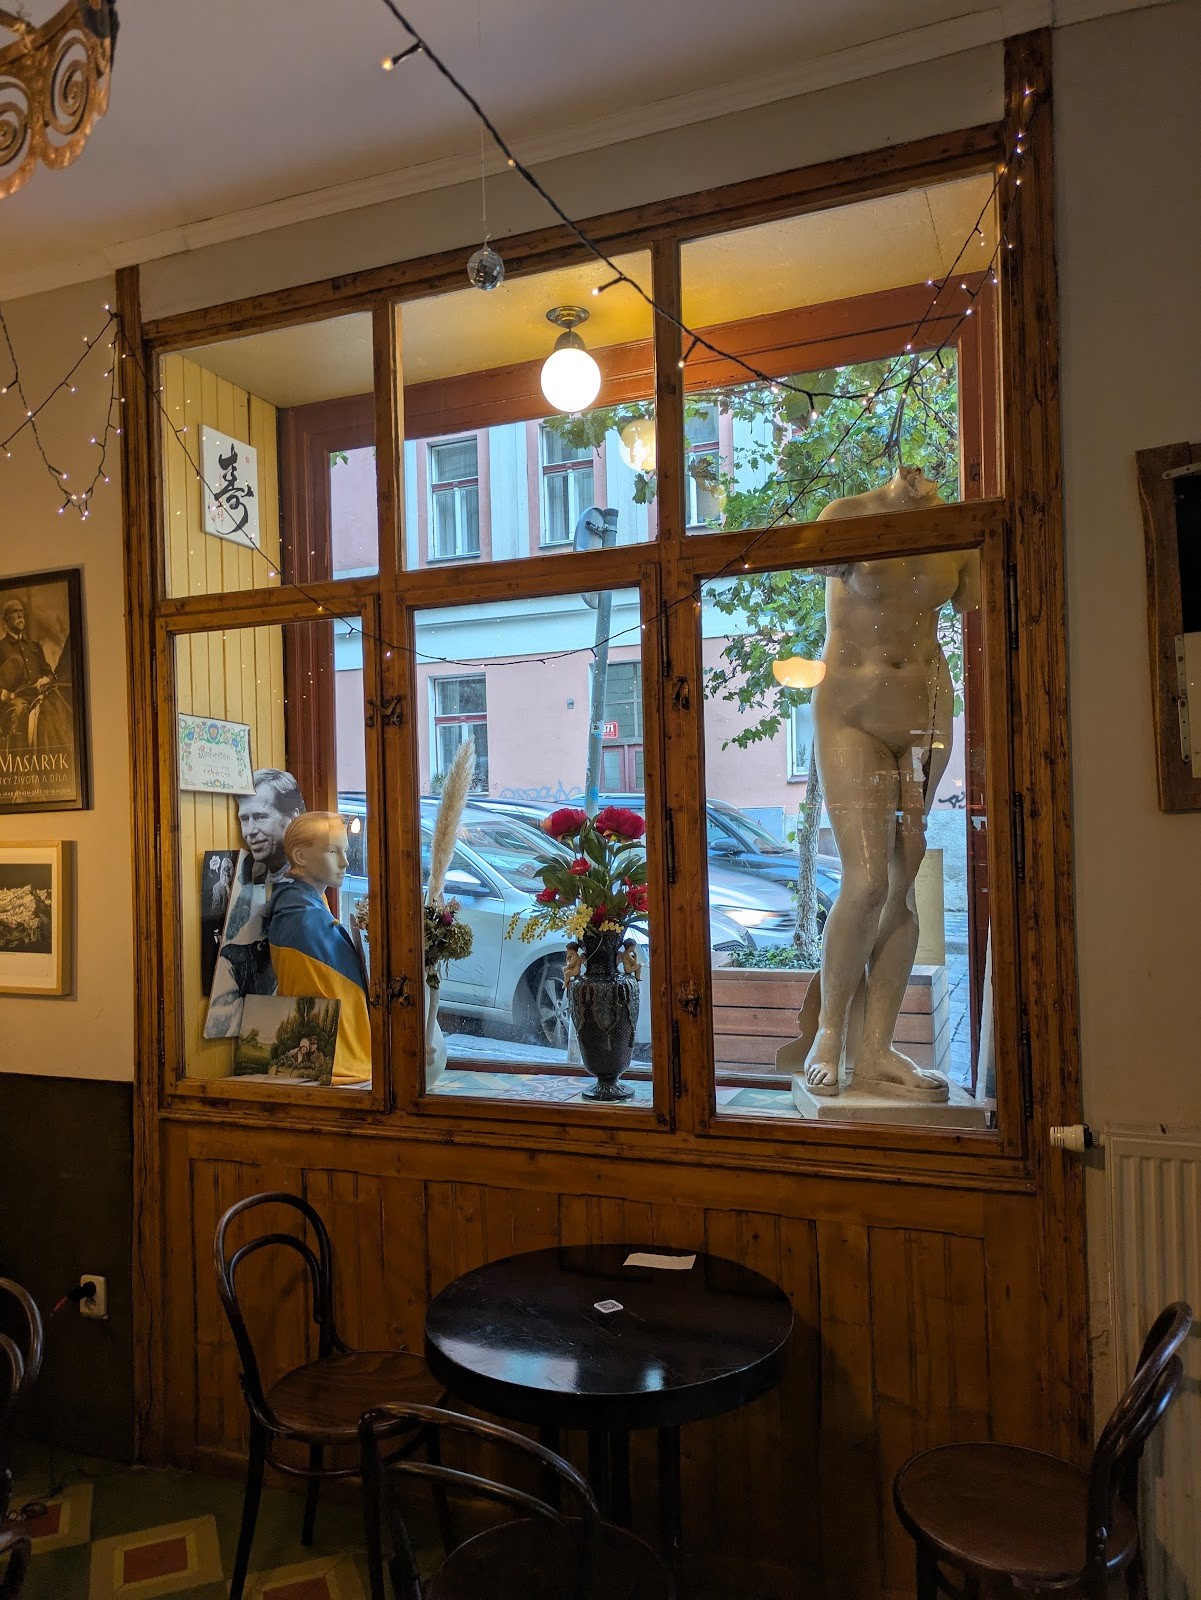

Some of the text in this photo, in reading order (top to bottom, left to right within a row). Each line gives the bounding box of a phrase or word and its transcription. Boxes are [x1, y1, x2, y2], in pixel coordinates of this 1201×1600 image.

[0, 753, 69, 773] MASARYK
[13, 774, 40, 785] ŽIVOTA
[42, 774, 48, 783] A
[50, 773, 68, 783] DÍLA
